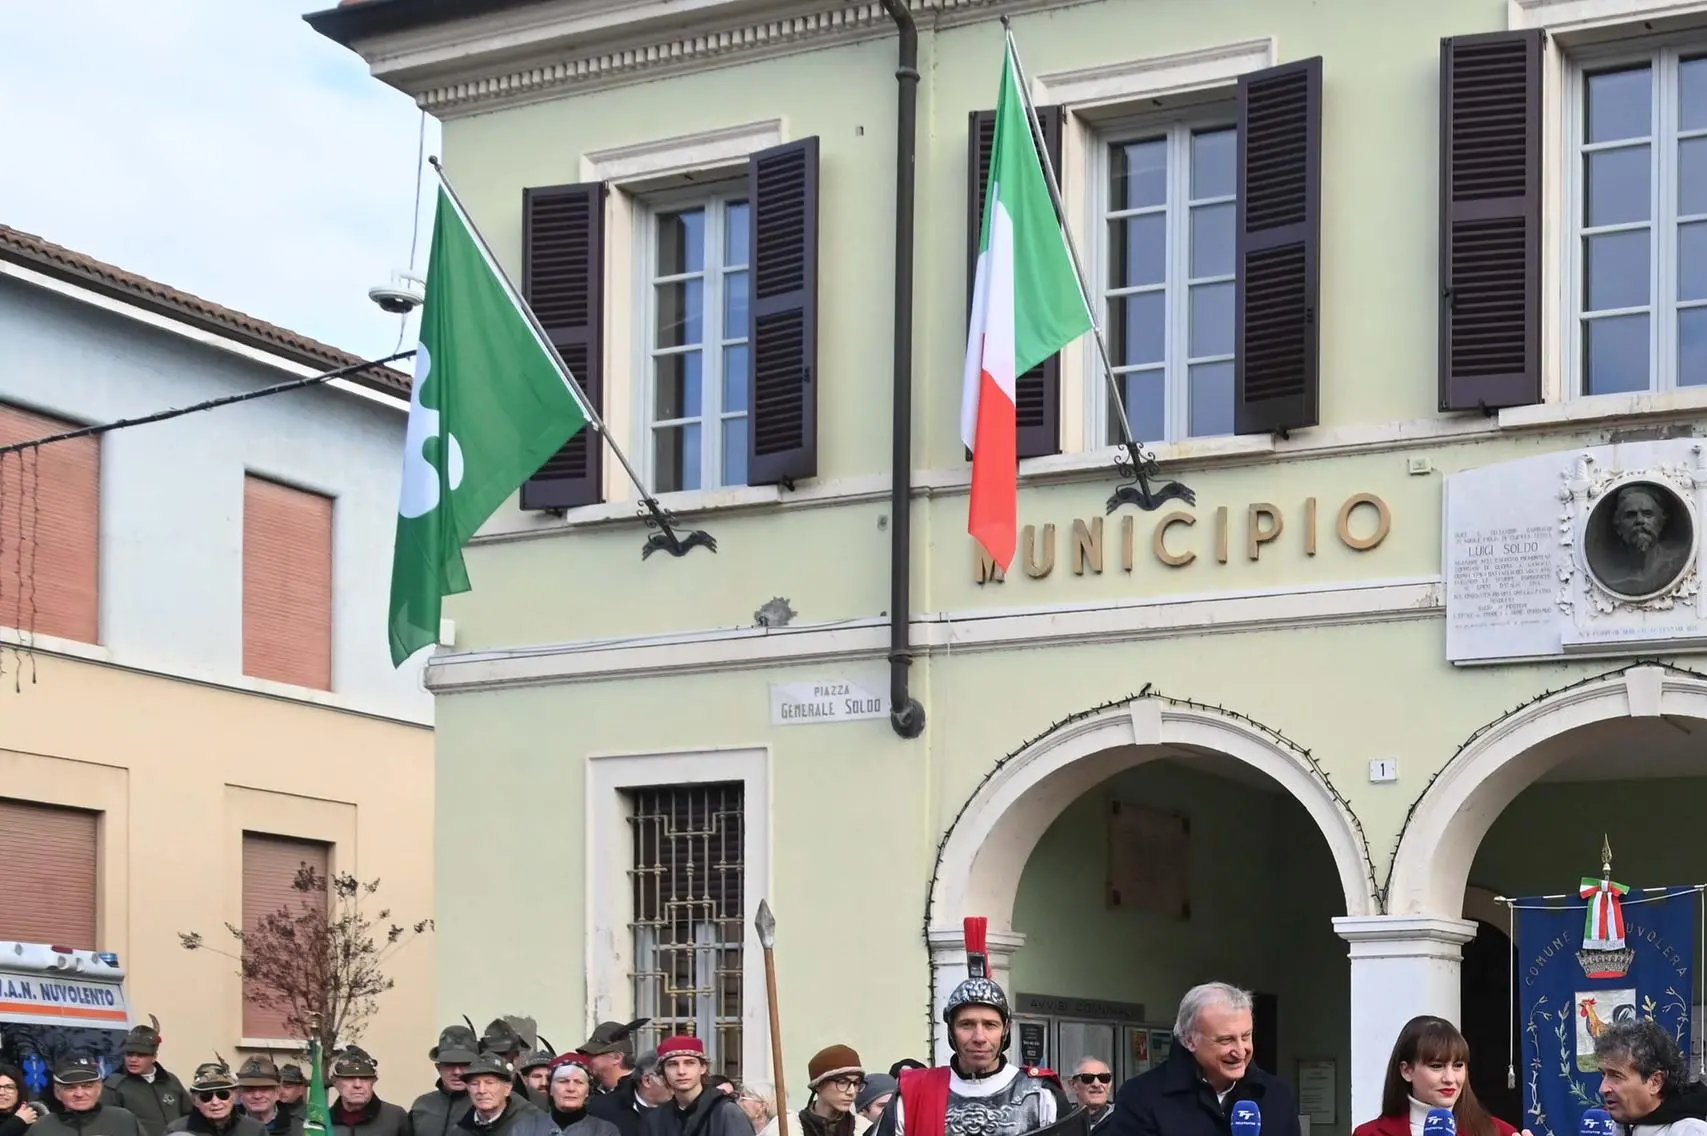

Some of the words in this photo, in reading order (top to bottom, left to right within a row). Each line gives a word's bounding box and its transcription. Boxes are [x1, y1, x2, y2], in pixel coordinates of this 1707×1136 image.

[1503, 542, 1538, 554] SOLDO
[814, 685, 850, 697] PIAZZA
[781, 702, 835, 719] GENERALE
[1525, 931, 1570, 986] COMUNE
[1626, 922, 1687, 977] UVOLERA
[40, 983, 115, 1006] NUVOLENTO
